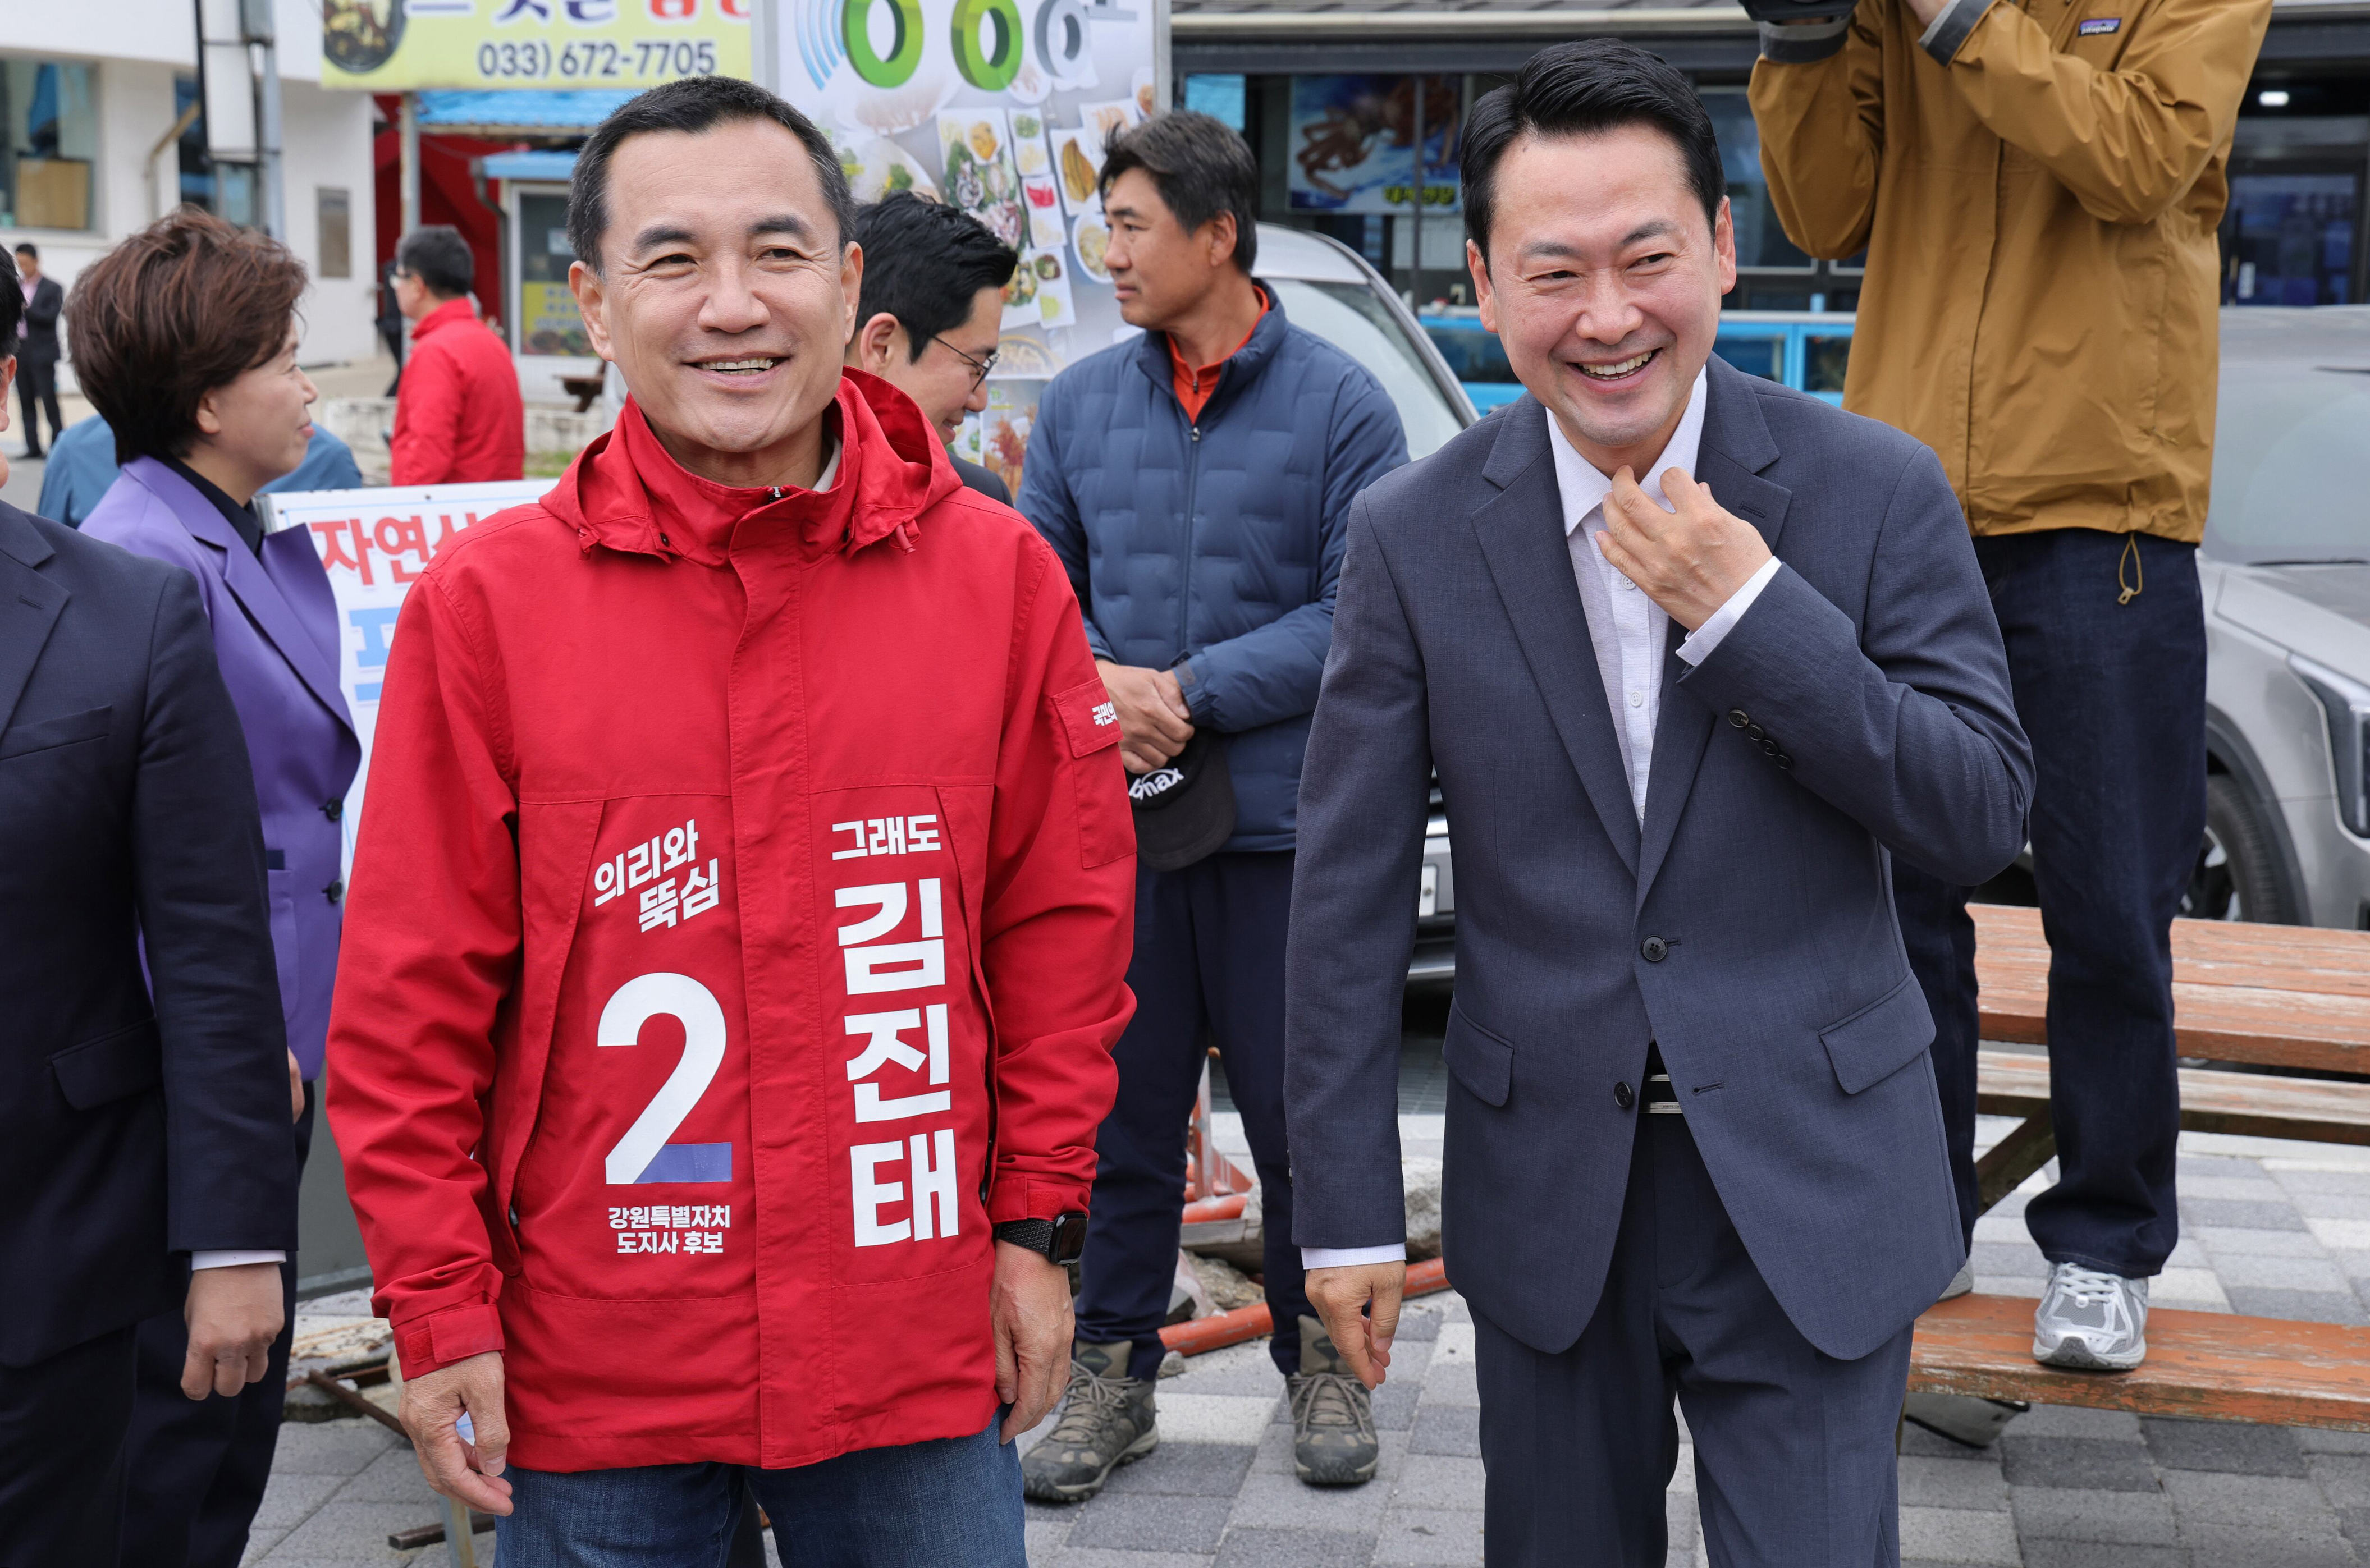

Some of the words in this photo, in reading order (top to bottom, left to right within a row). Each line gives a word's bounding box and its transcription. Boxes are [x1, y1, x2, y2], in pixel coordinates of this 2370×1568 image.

[478, 42, 551, 77] 033)
[560, 42, 715, 76] 672-7705
[594, 819, 699, 907] 의리와
[831, 814, 942, 860] 그래도
[638, 857, 720, 933] 뚝심
[597, 971, 733, 1185] 2
[834, 877, 959, 1248] 김진태
[608, 1205, 731, 1230] 강원특별자치
[617, 1231, 679, 1254] 도지사
[683, 1230, 724, 1255] 후보
